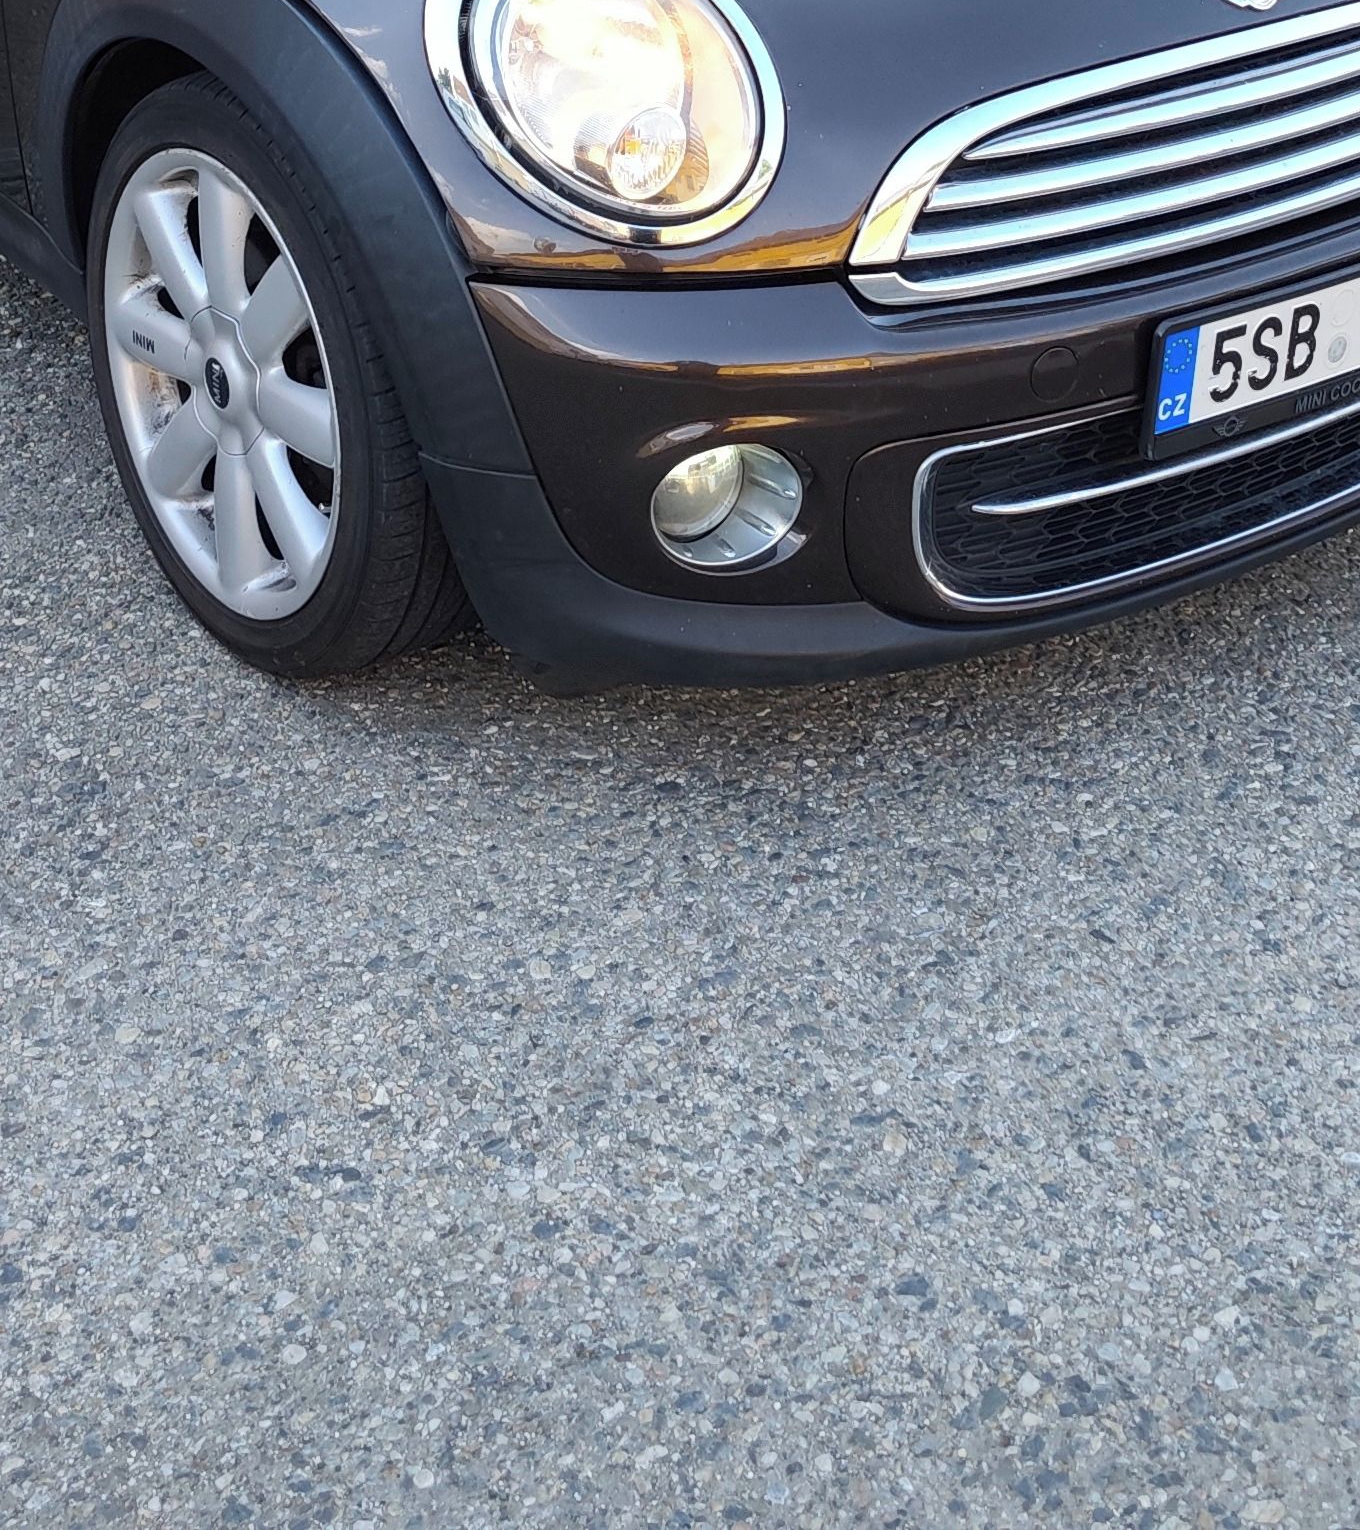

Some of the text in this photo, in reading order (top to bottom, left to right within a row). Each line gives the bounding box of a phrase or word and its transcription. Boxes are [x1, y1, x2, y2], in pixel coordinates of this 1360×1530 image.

[132, 330, 155, 354] MINI
[1208, 302, 1321, 403] 5SB
[1158, 393, 1187, 420] CZ
[1295, 391, 1327, 413] MINI
